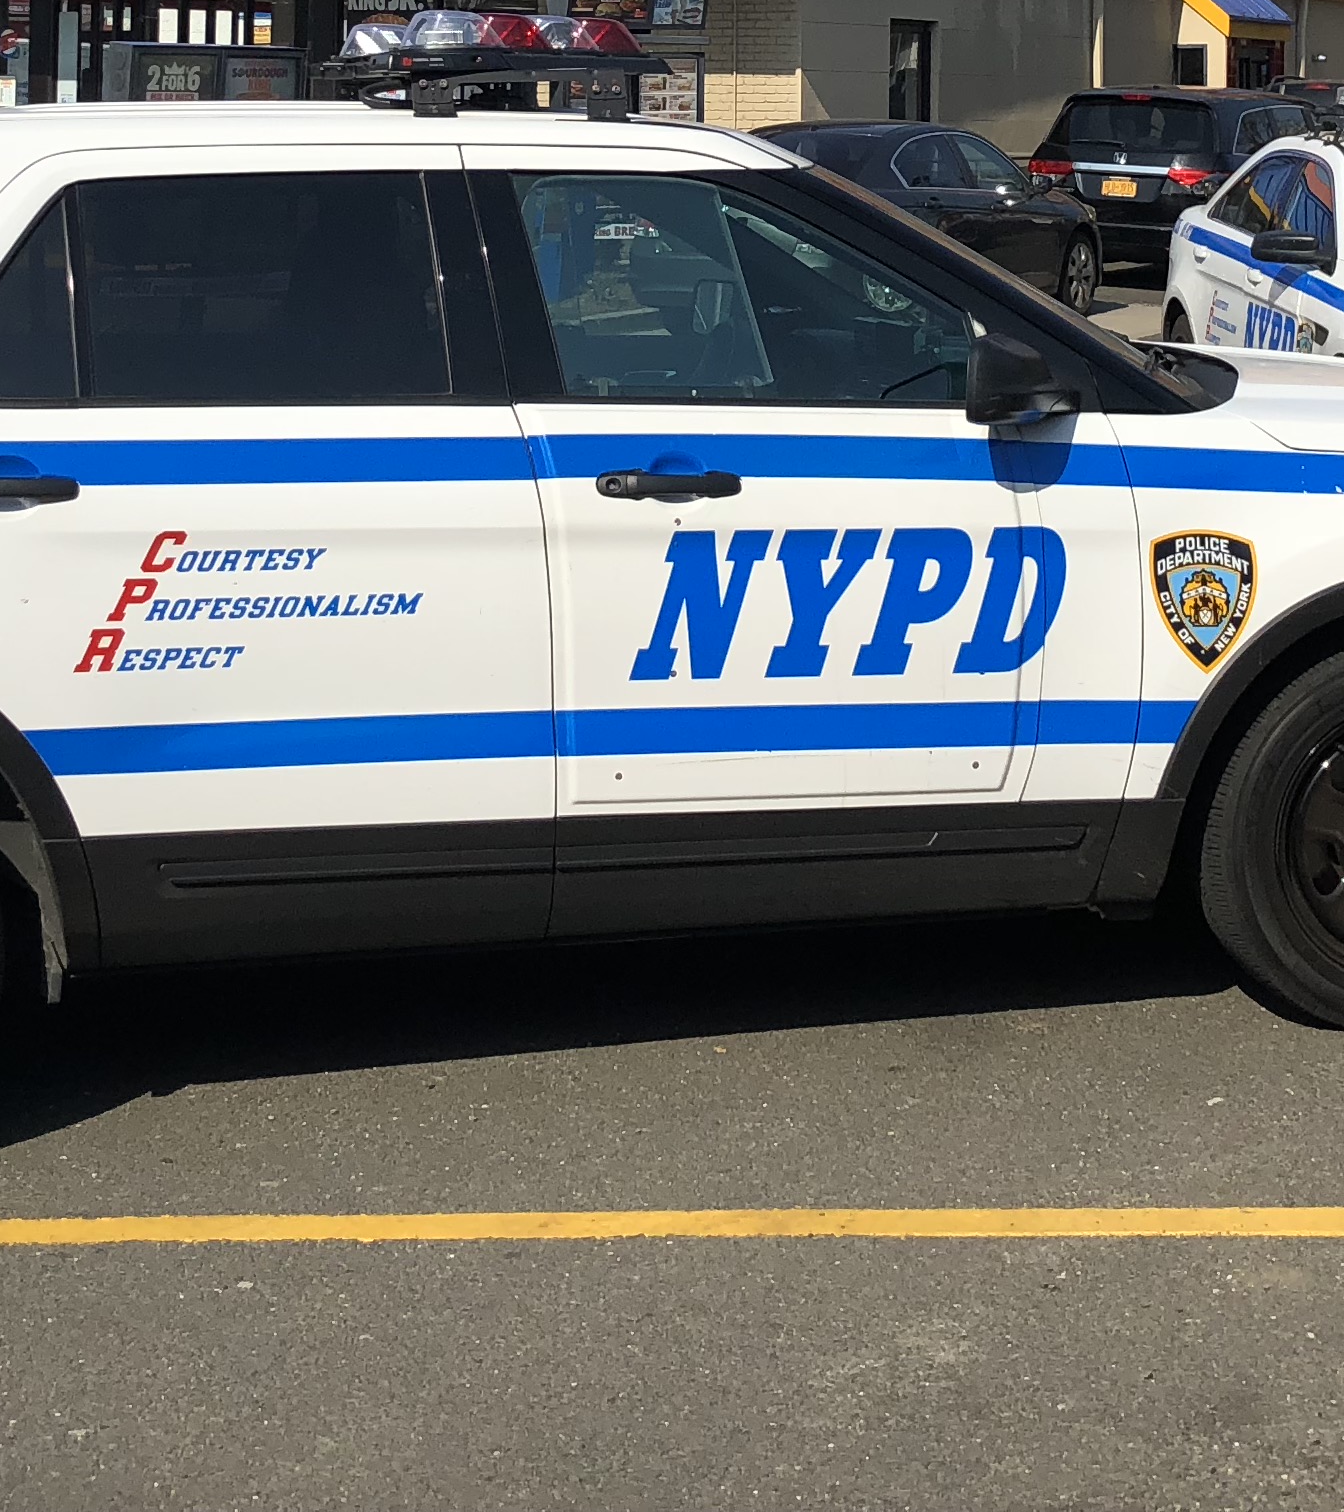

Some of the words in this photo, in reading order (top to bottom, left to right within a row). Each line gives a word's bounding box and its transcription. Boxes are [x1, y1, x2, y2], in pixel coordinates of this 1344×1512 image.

[146, 65, 161, 90] 2
[161, 75, 185, 91] FOR
[1244, 302, 1297, 352] NYPD
[140, 530, 327, 573] COURTESY
[1156, 550, 1250, 576] DEPARTMENT
[1175, 536, 1230, 554] POLICE
[106, 578, 424, 623] PROFESSIONALISM
[629, 526, 1067, 682] NYPD
[1159, 591, 1181, 624] CITY
[1177, 628, 1196, 645] OF
[1213, 622, 1237, 652] NEW
[1232, 582, 1252, 619] YORK
[72, 628, 245, 673] RESPECT
